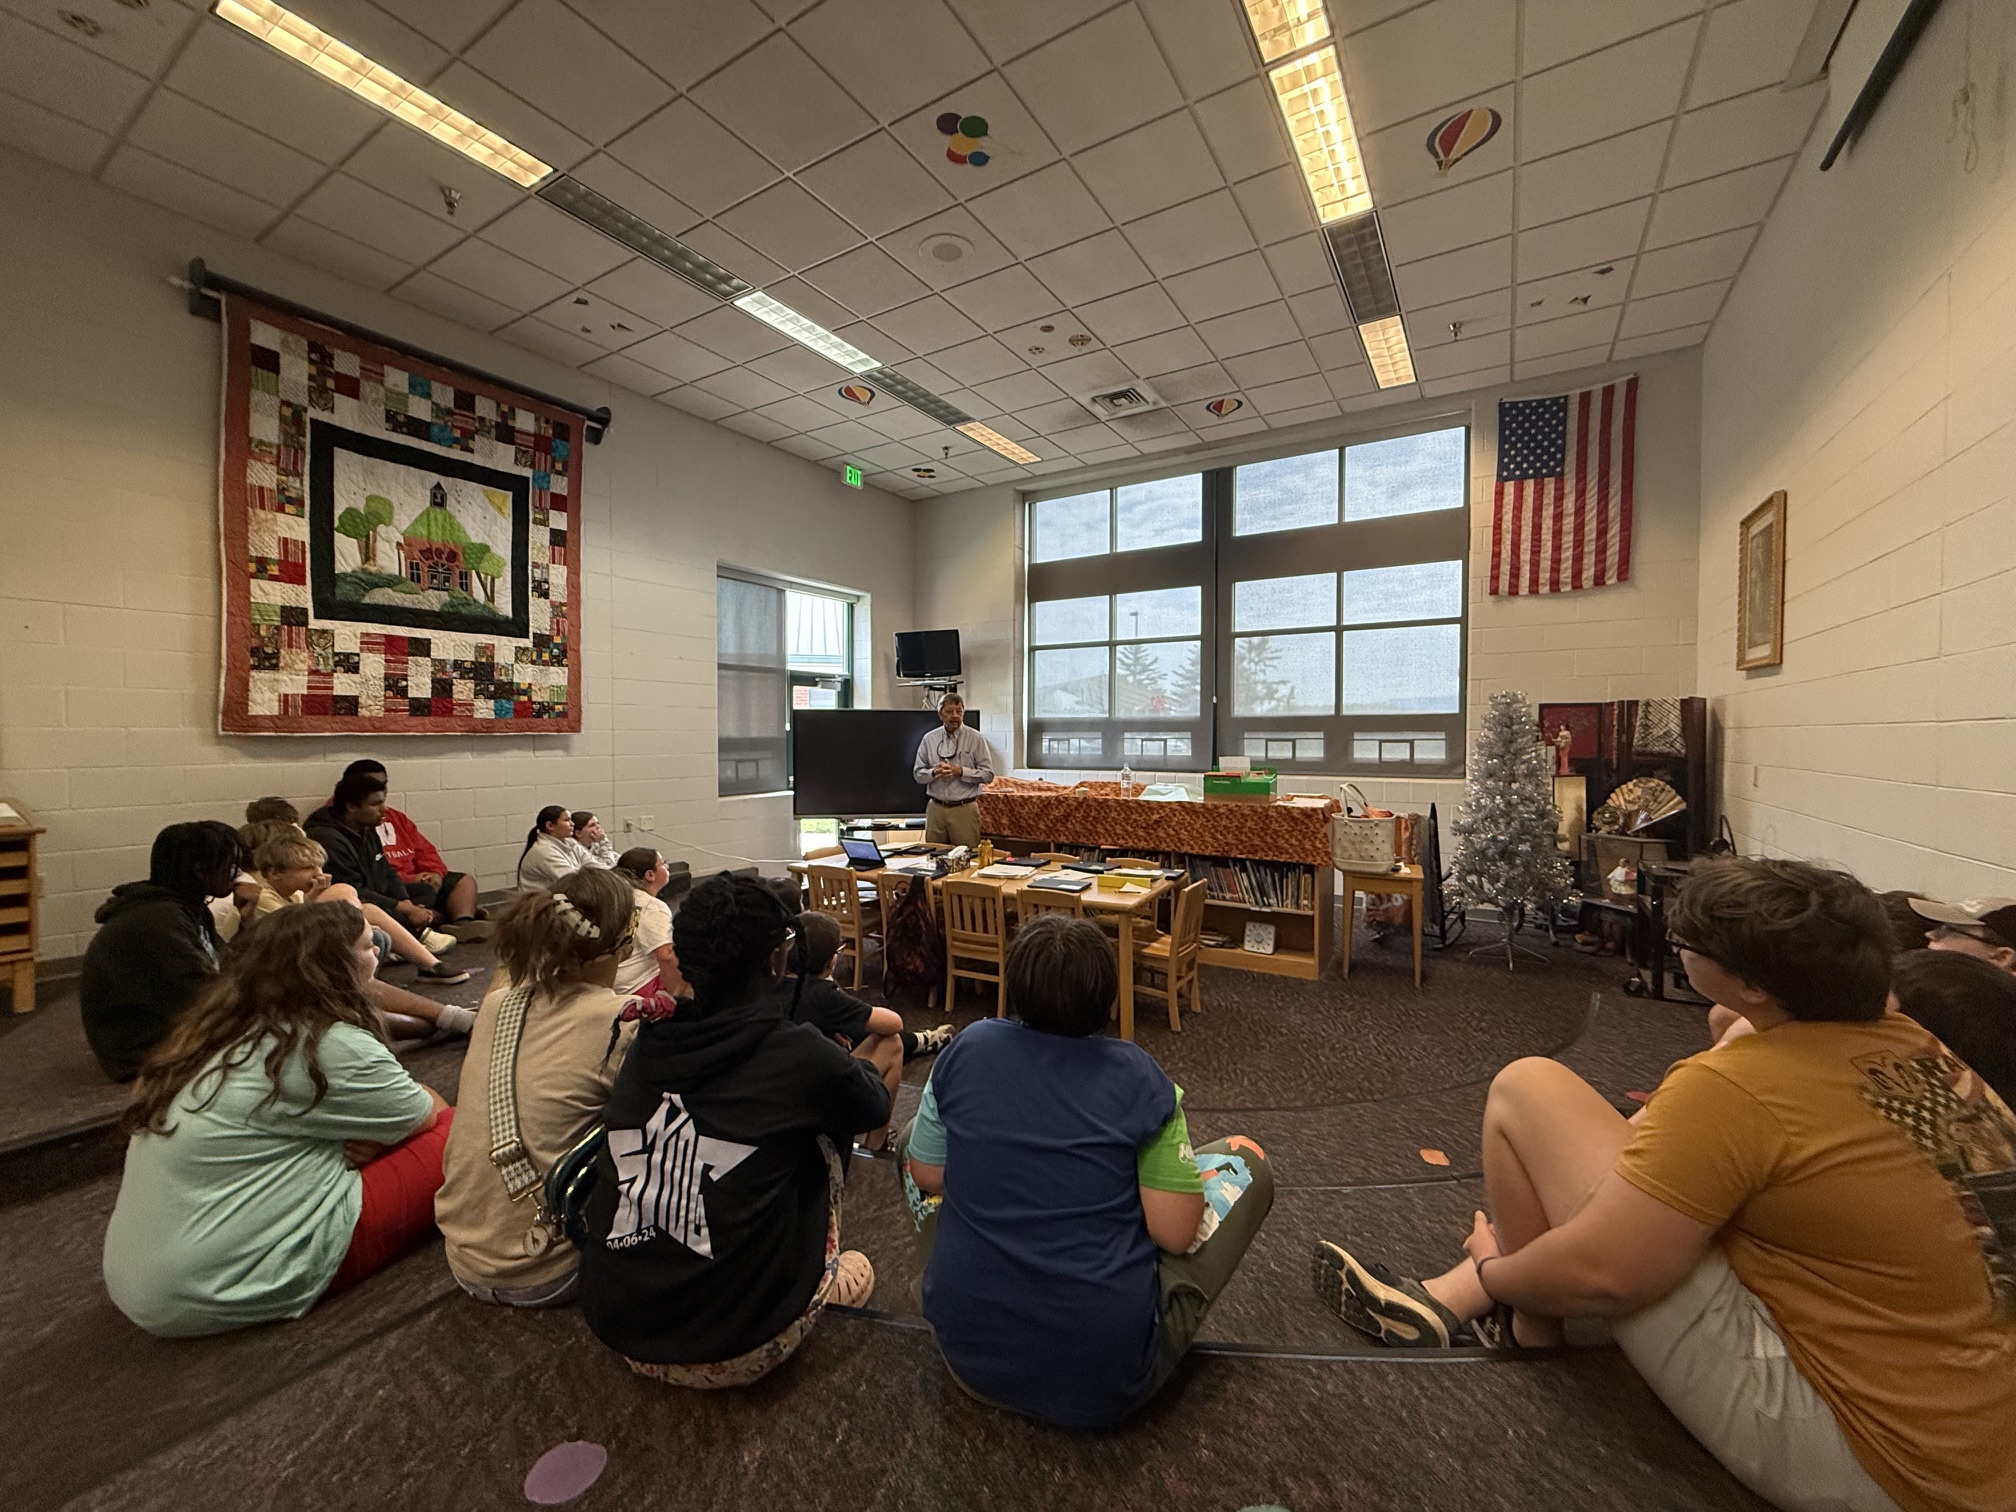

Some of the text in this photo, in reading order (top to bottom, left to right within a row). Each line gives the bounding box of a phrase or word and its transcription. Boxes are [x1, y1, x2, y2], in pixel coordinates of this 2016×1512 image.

[847, 466, 862, 487] EXIT
[375, 822, 397, 847] N
[385, 848, 415, 859] TBALL
